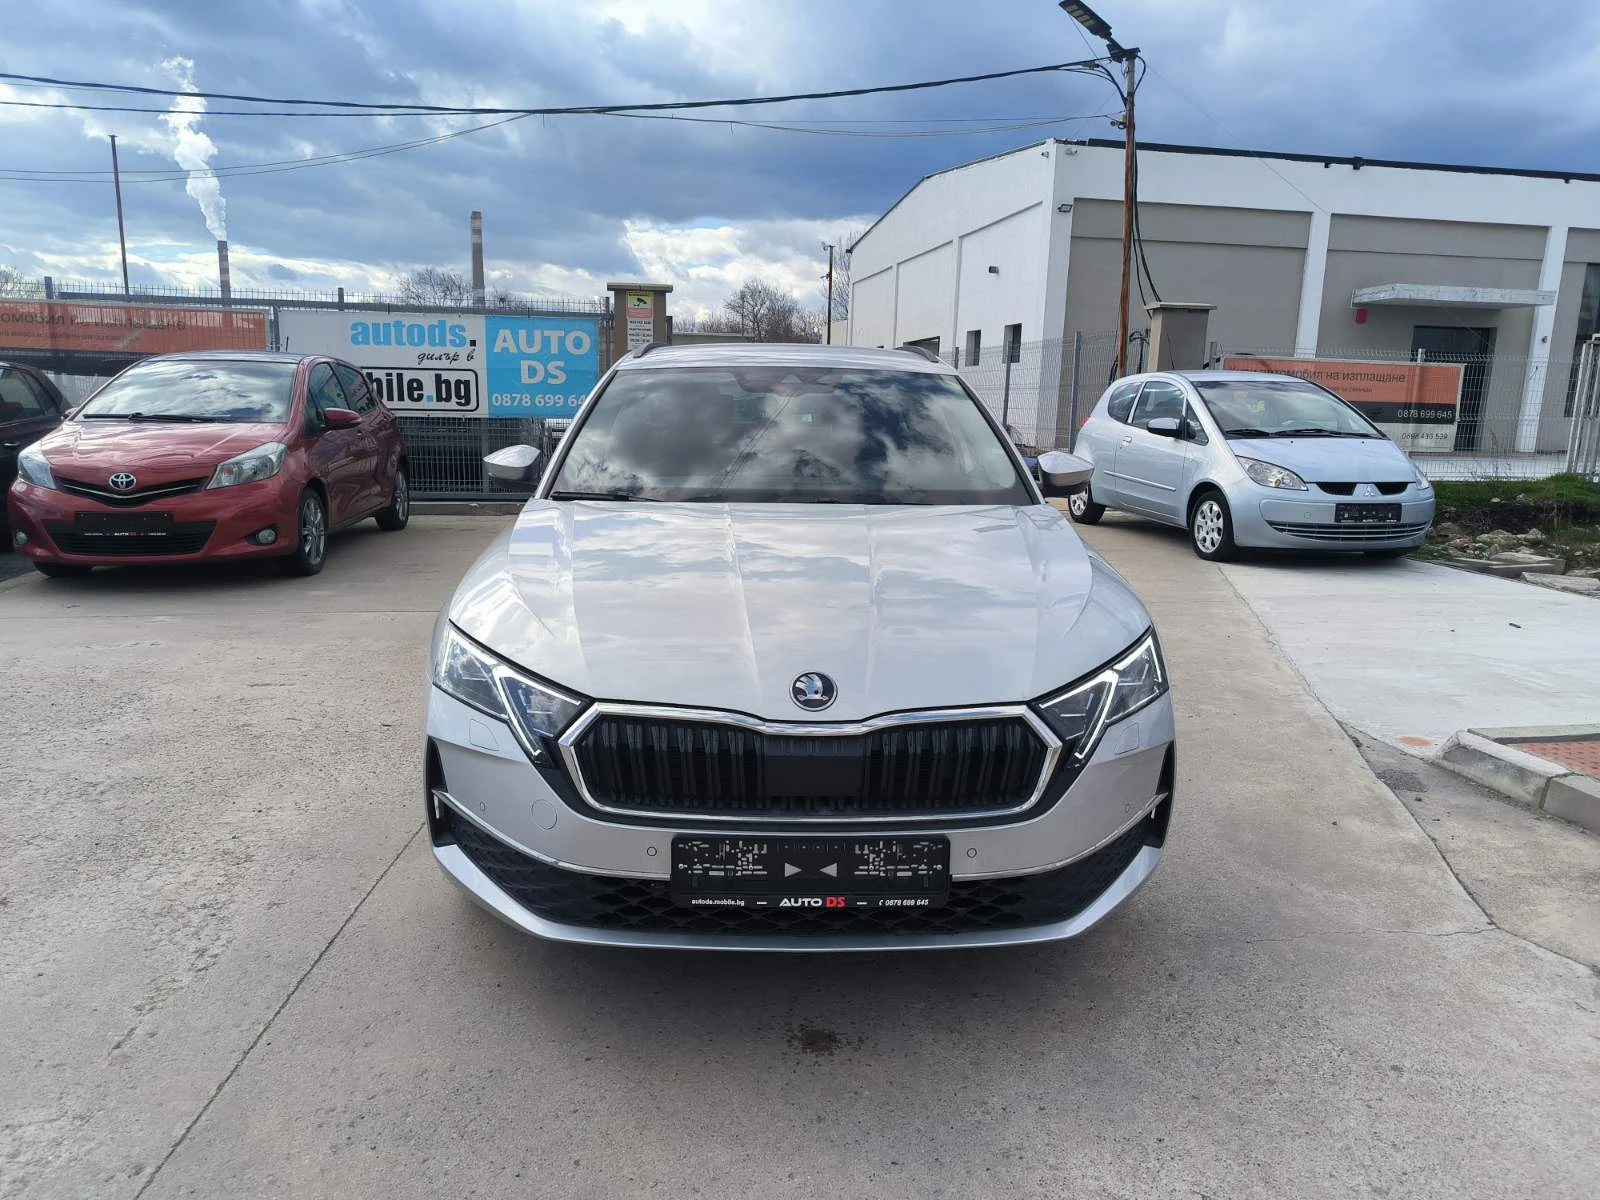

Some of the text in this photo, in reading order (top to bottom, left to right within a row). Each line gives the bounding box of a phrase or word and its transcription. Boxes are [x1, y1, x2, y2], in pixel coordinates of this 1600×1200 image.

[493, 329, 591, 355] AUTO
[520, 360, 567, 384] DS
[1326, 372, 1339, 381] на
[1342, 372, 1406, 383] изплащане
[492, 393, 531, 407] 0878
[535, 394, 564, 407] 699
[1397, 409, 1453, 419] 0878 699 645
[779, 898, 822, 907] AUTO
[825, 897, 846, 907] DS
